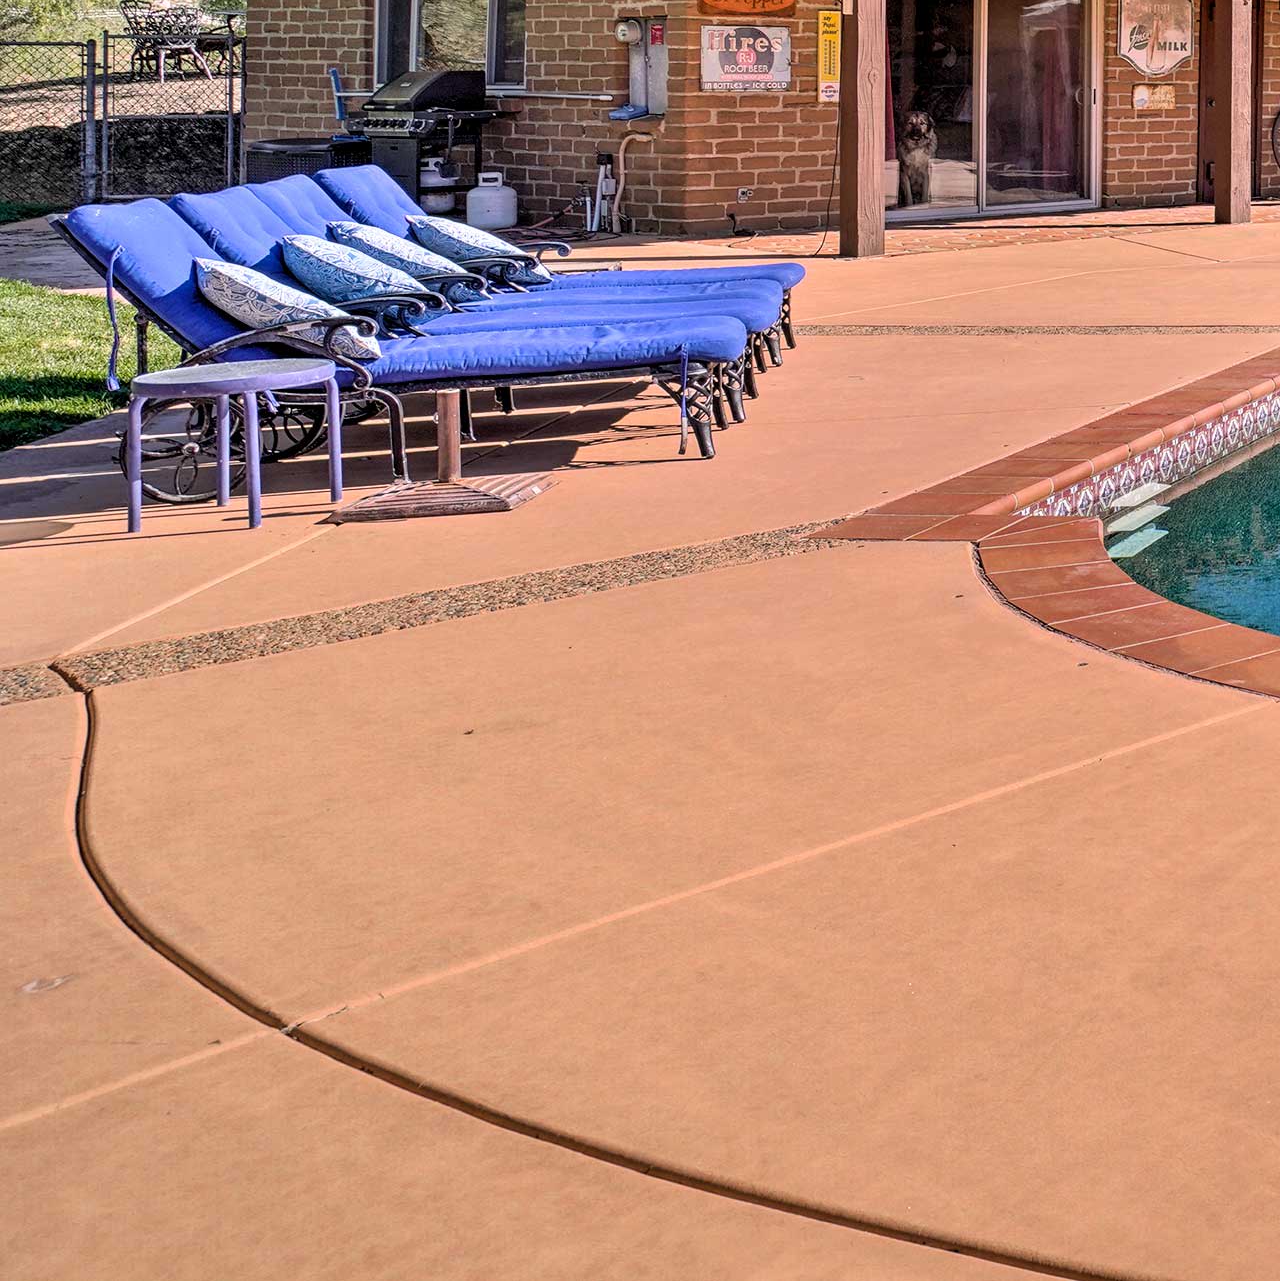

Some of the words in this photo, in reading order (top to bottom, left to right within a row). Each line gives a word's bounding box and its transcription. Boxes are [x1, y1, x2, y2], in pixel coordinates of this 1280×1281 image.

[707, 30, 783, 52] Hires
[1157, 41, 1188, 51] MILK
[724, 65, 747, 73] ROOT
[748, 65, 769, 73] BEER
